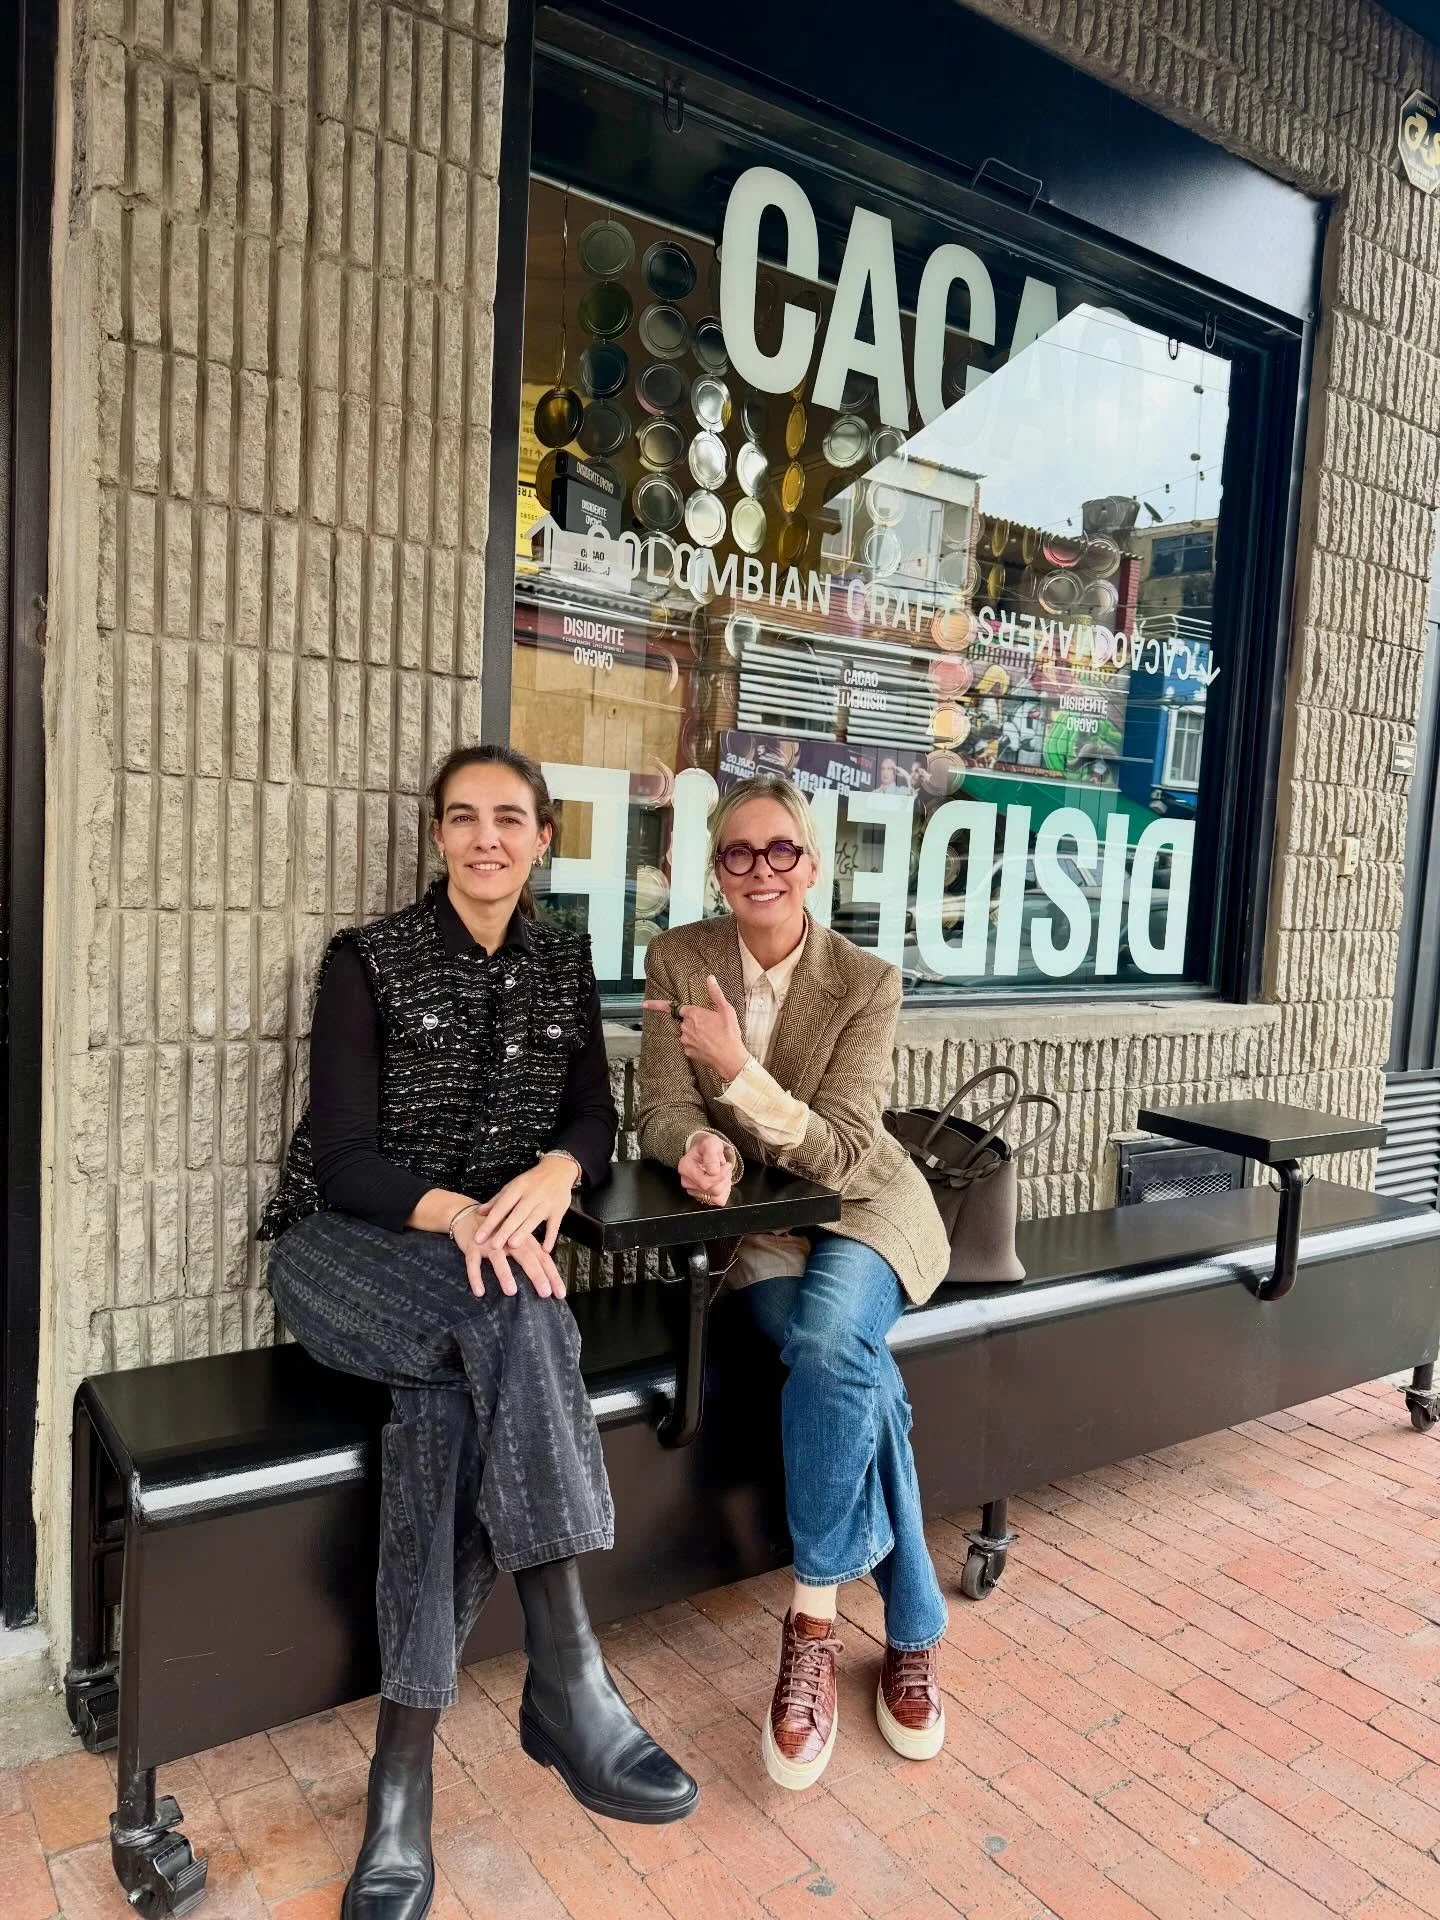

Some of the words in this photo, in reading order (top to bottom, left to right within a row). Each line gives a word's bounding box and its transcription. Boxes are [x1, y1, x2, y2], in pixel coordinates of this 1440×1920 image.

[563, 616, 625, 647] DISIDENTE
[573, 646, 614, 671] CACAO
[843, 668, 879, 688] CACAO
[1060, 695, 1108, 714] DISIDENTE
[1066, 717, 1099, 734] CACAO
[540, 761, 1196, 982] DISIDETE
